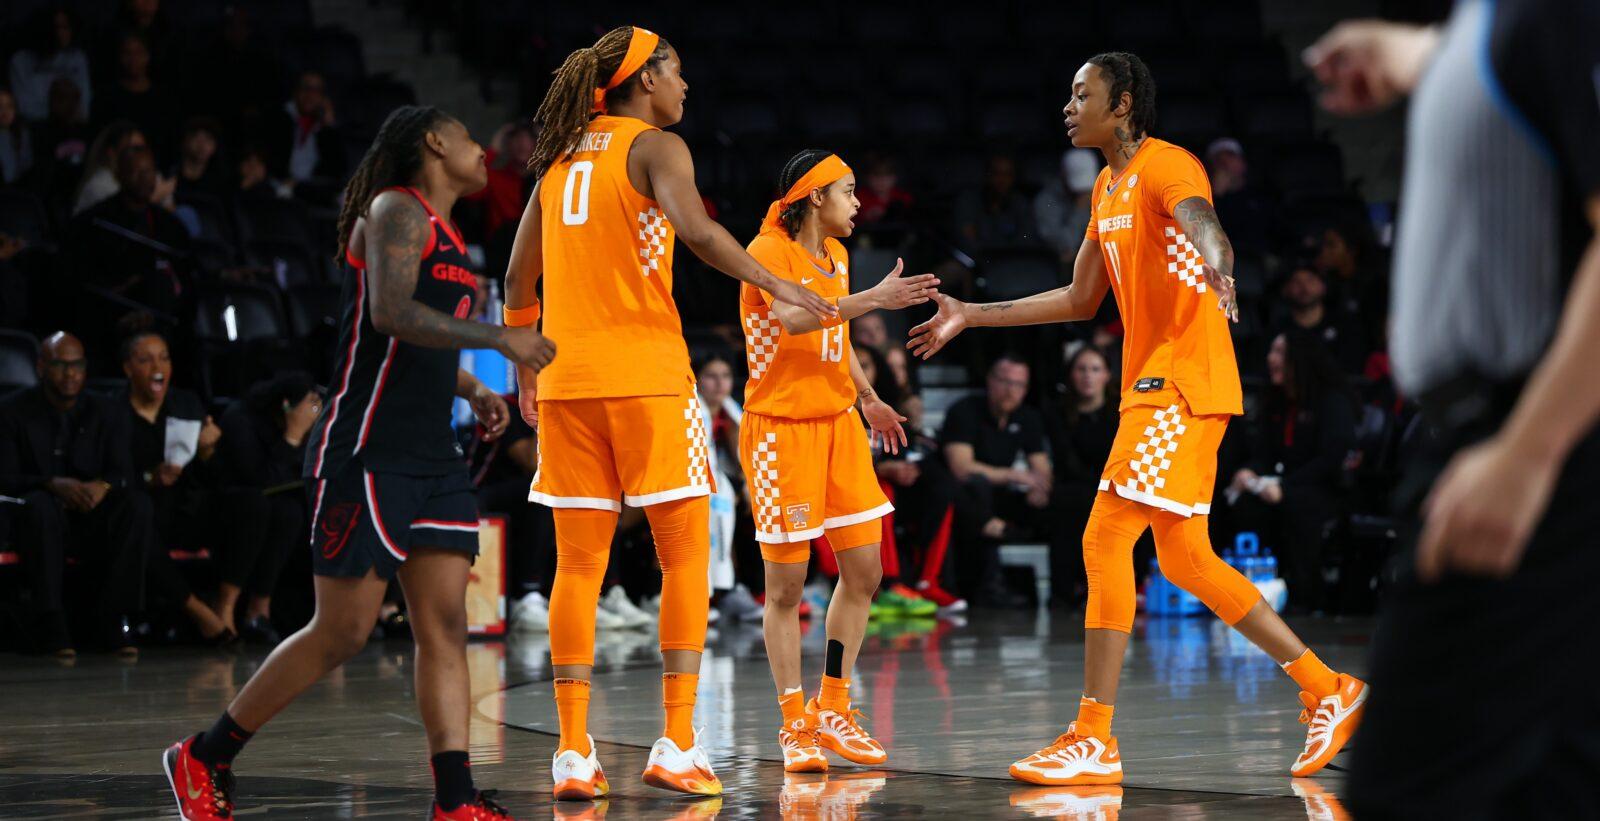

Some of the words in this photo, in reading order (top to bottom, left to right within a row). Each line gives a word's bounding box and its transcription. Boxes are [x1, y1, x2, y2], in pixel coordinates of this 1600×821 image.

[564, 132, 613, 154] RKER
[562, 160, 594, 226] 0
[820, 324, 844, 363] 13
